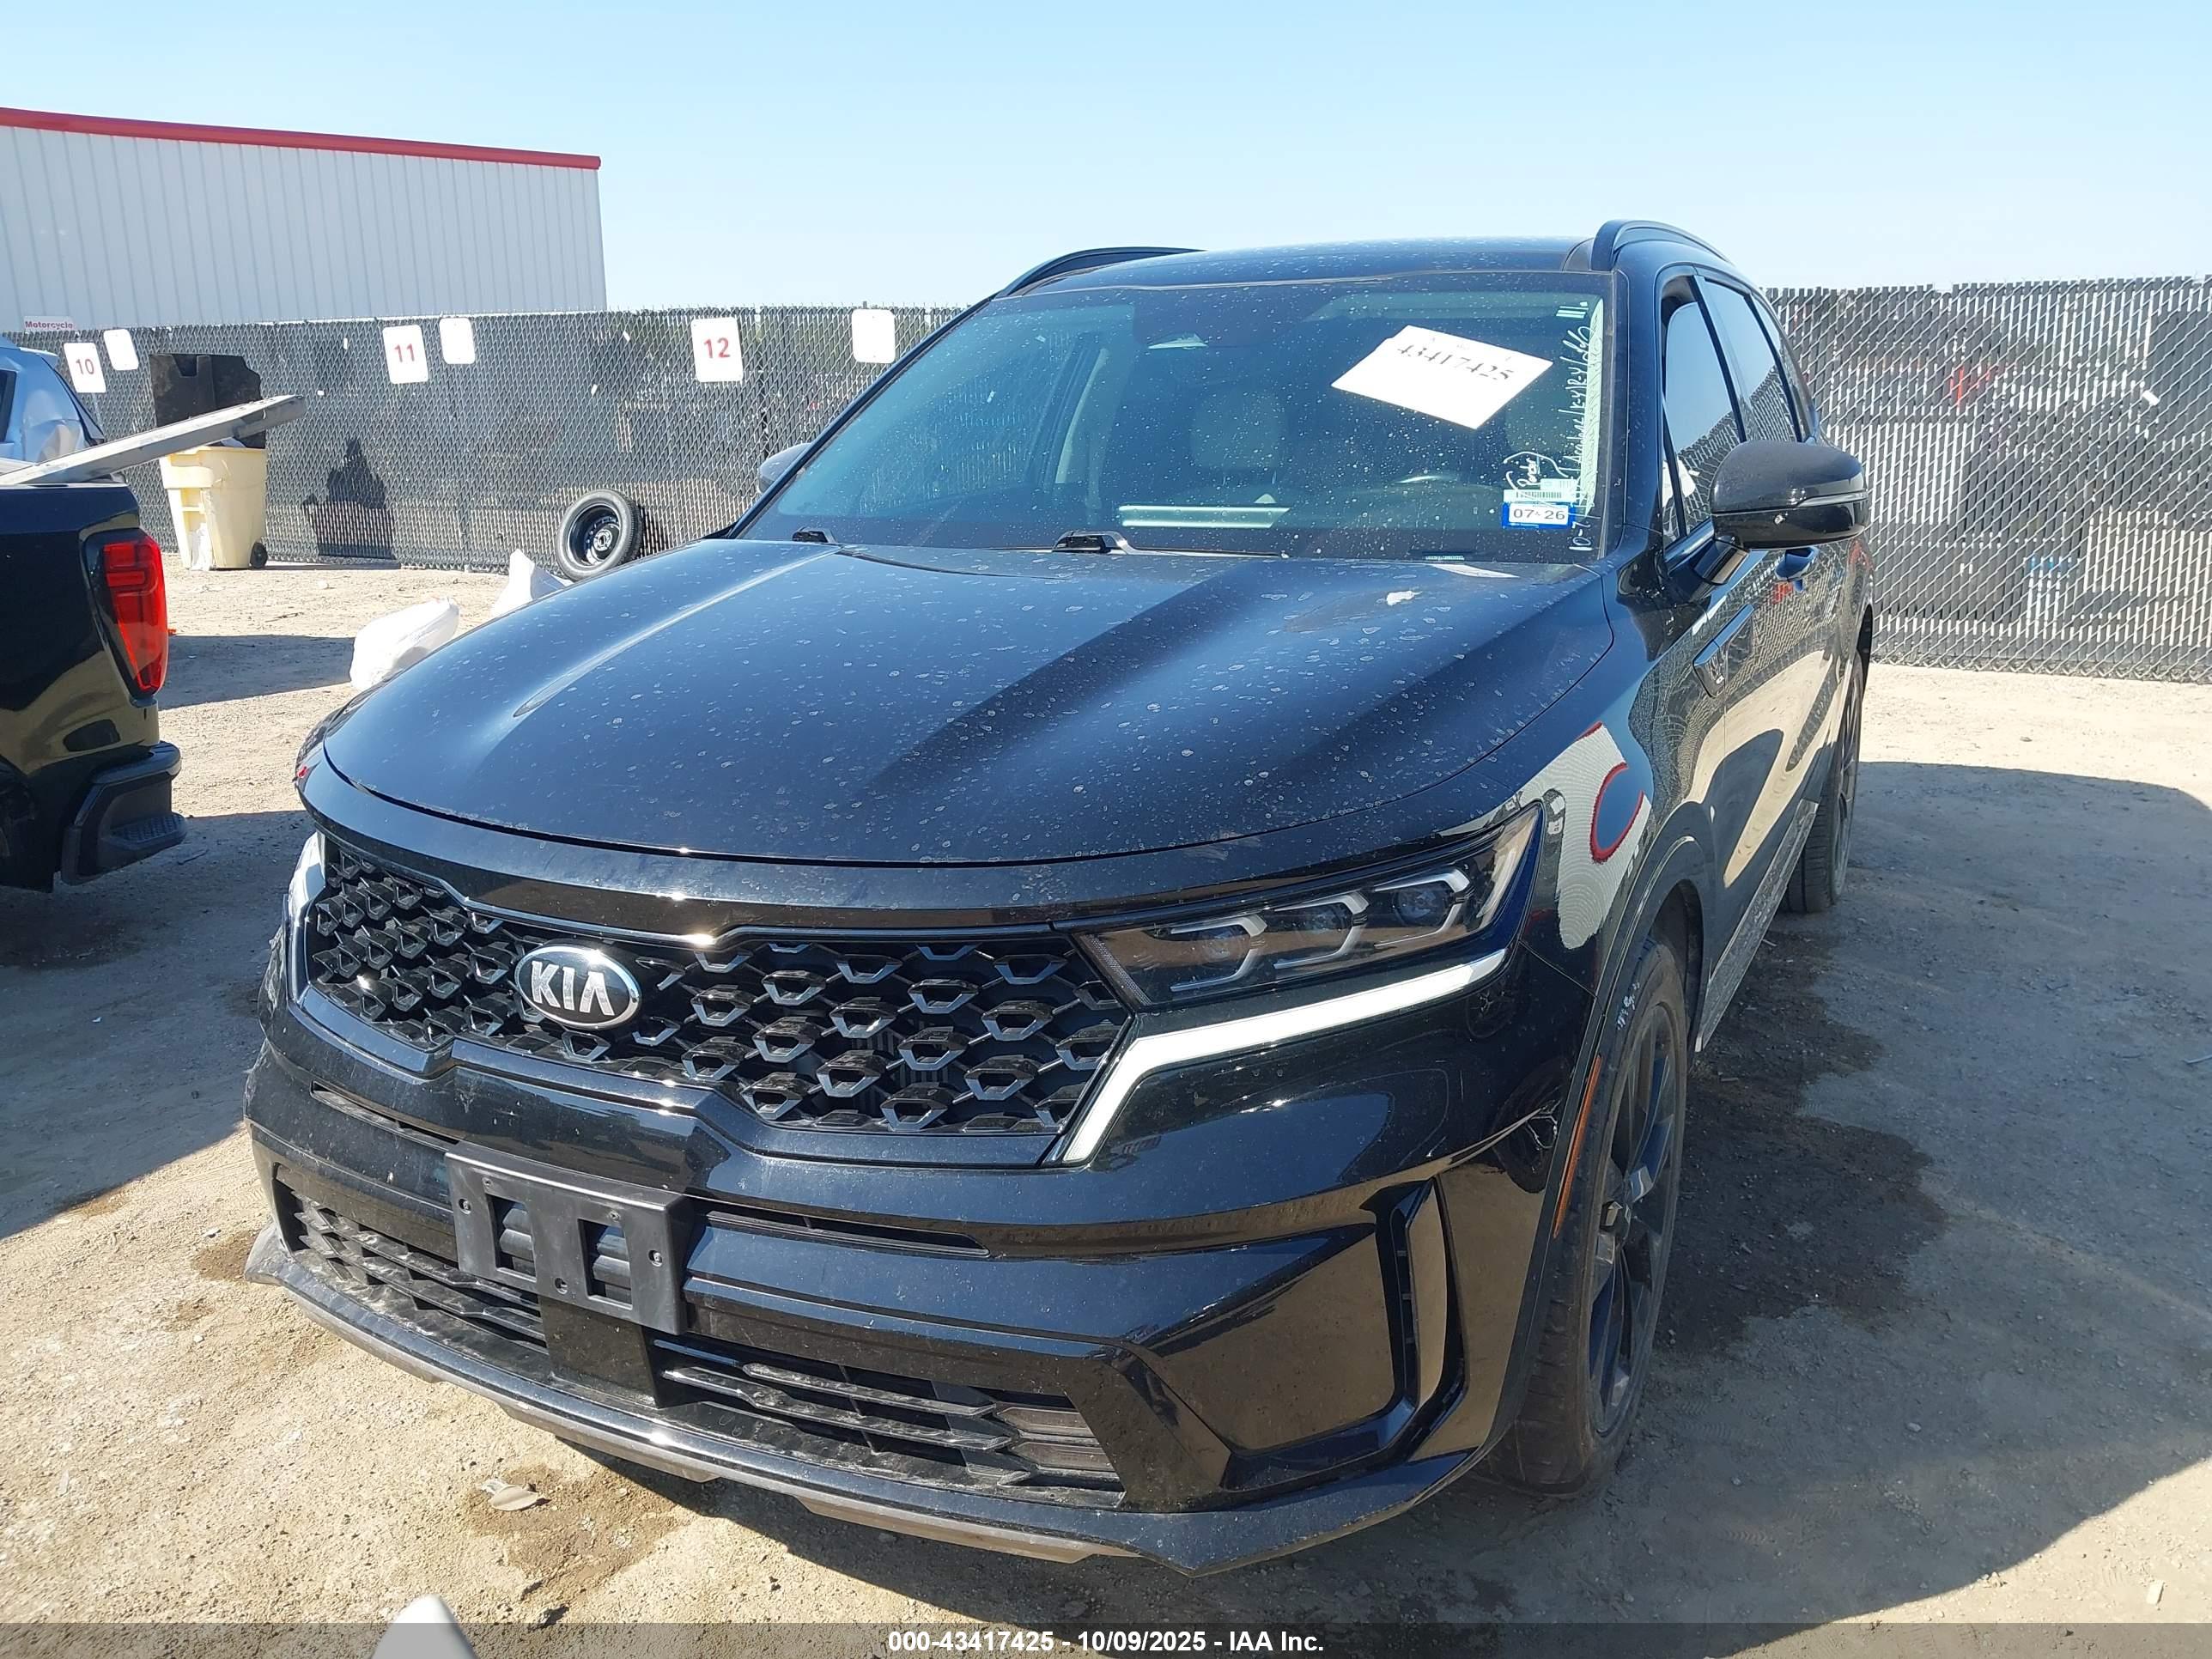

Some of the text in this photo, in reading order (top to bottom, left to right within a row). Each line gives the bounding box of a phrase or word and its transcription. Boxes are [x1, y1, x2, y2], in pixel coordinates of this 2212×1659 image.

[394, 343, 415, 362] 11
[703, 337, 731, 359] 12
[76, 358, 94, 375] 10
[1397, 344, 1514, 380] 43417425
[531, 960, 615, 1016] KIA
